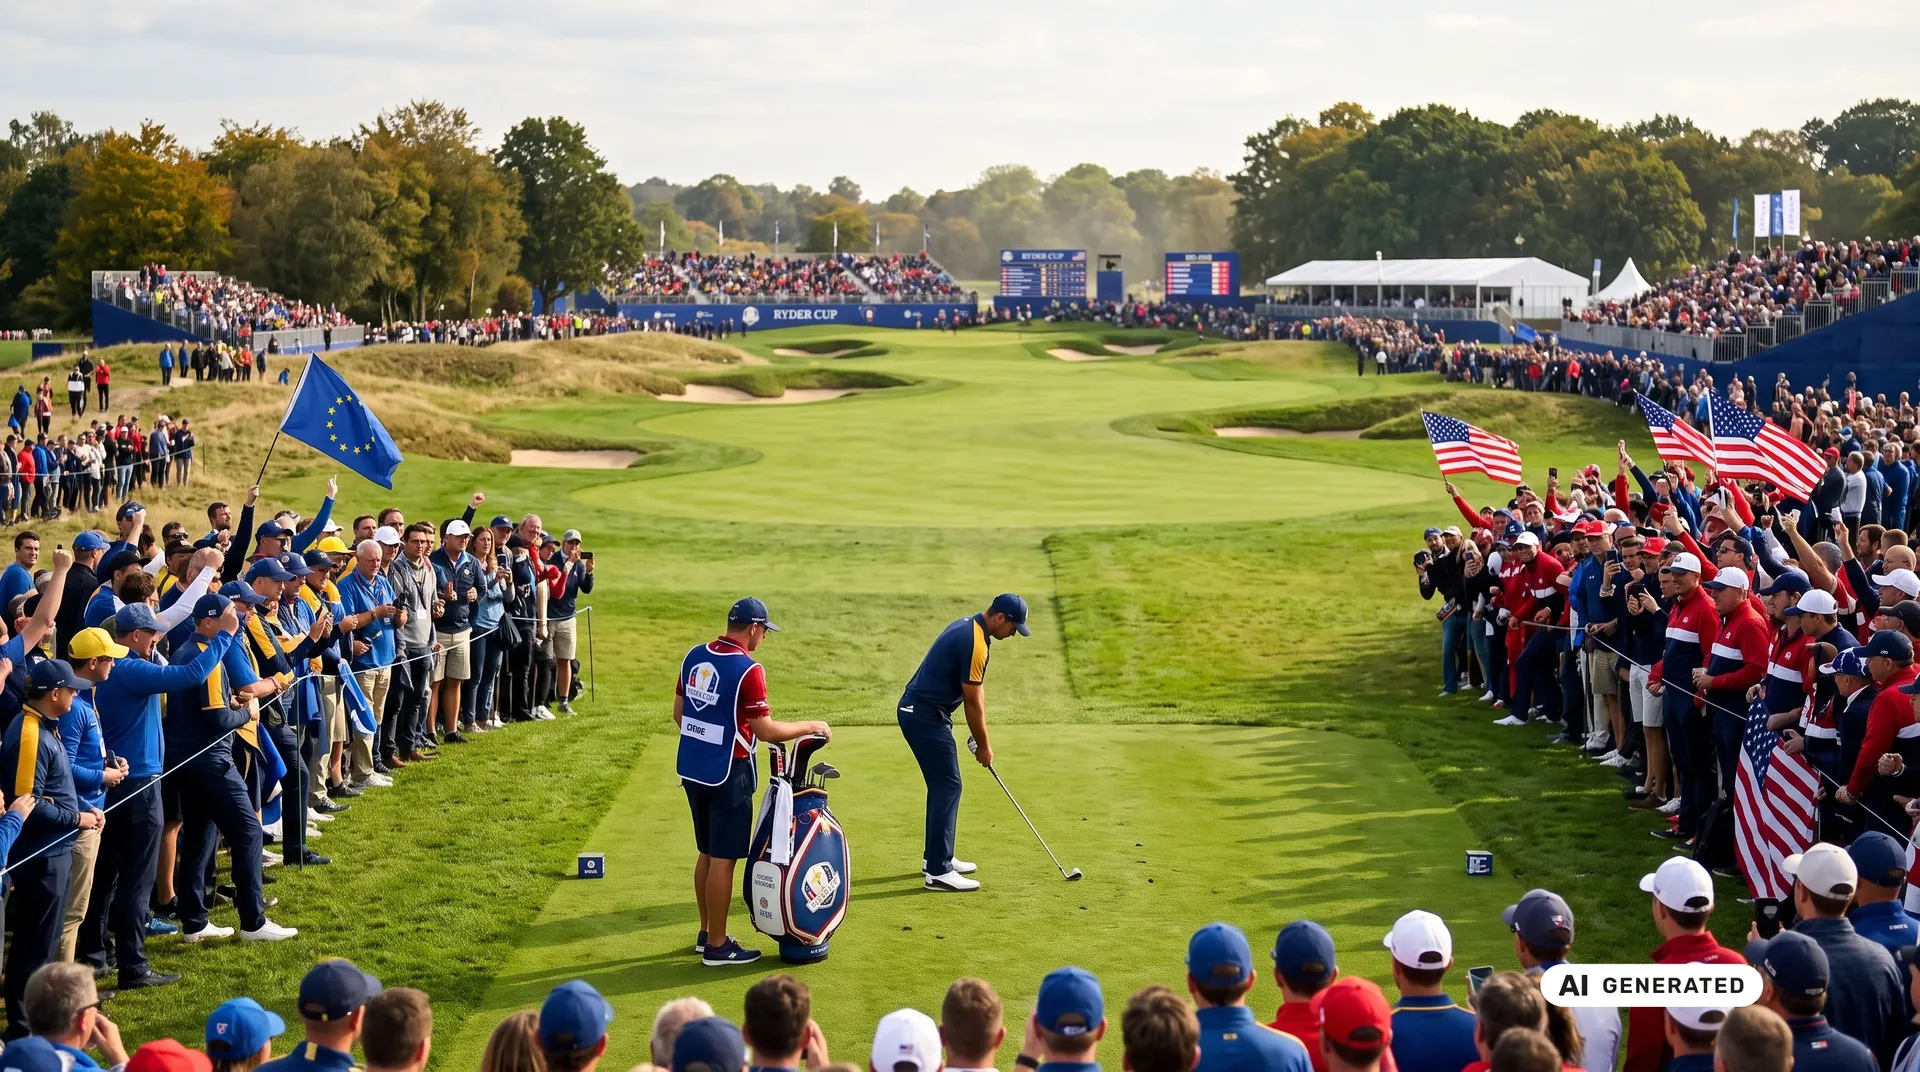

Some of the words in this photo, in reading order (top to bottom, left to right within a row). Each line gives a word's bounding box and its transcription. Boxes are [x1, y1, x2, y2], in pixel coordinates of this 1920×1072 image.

[1021, 252, 1047, 260] RYDER
[1047, 252, 1064, 260] CUP
[773, 309, 812, 320] RYDER
[813, 309, 838, 320] CUP
